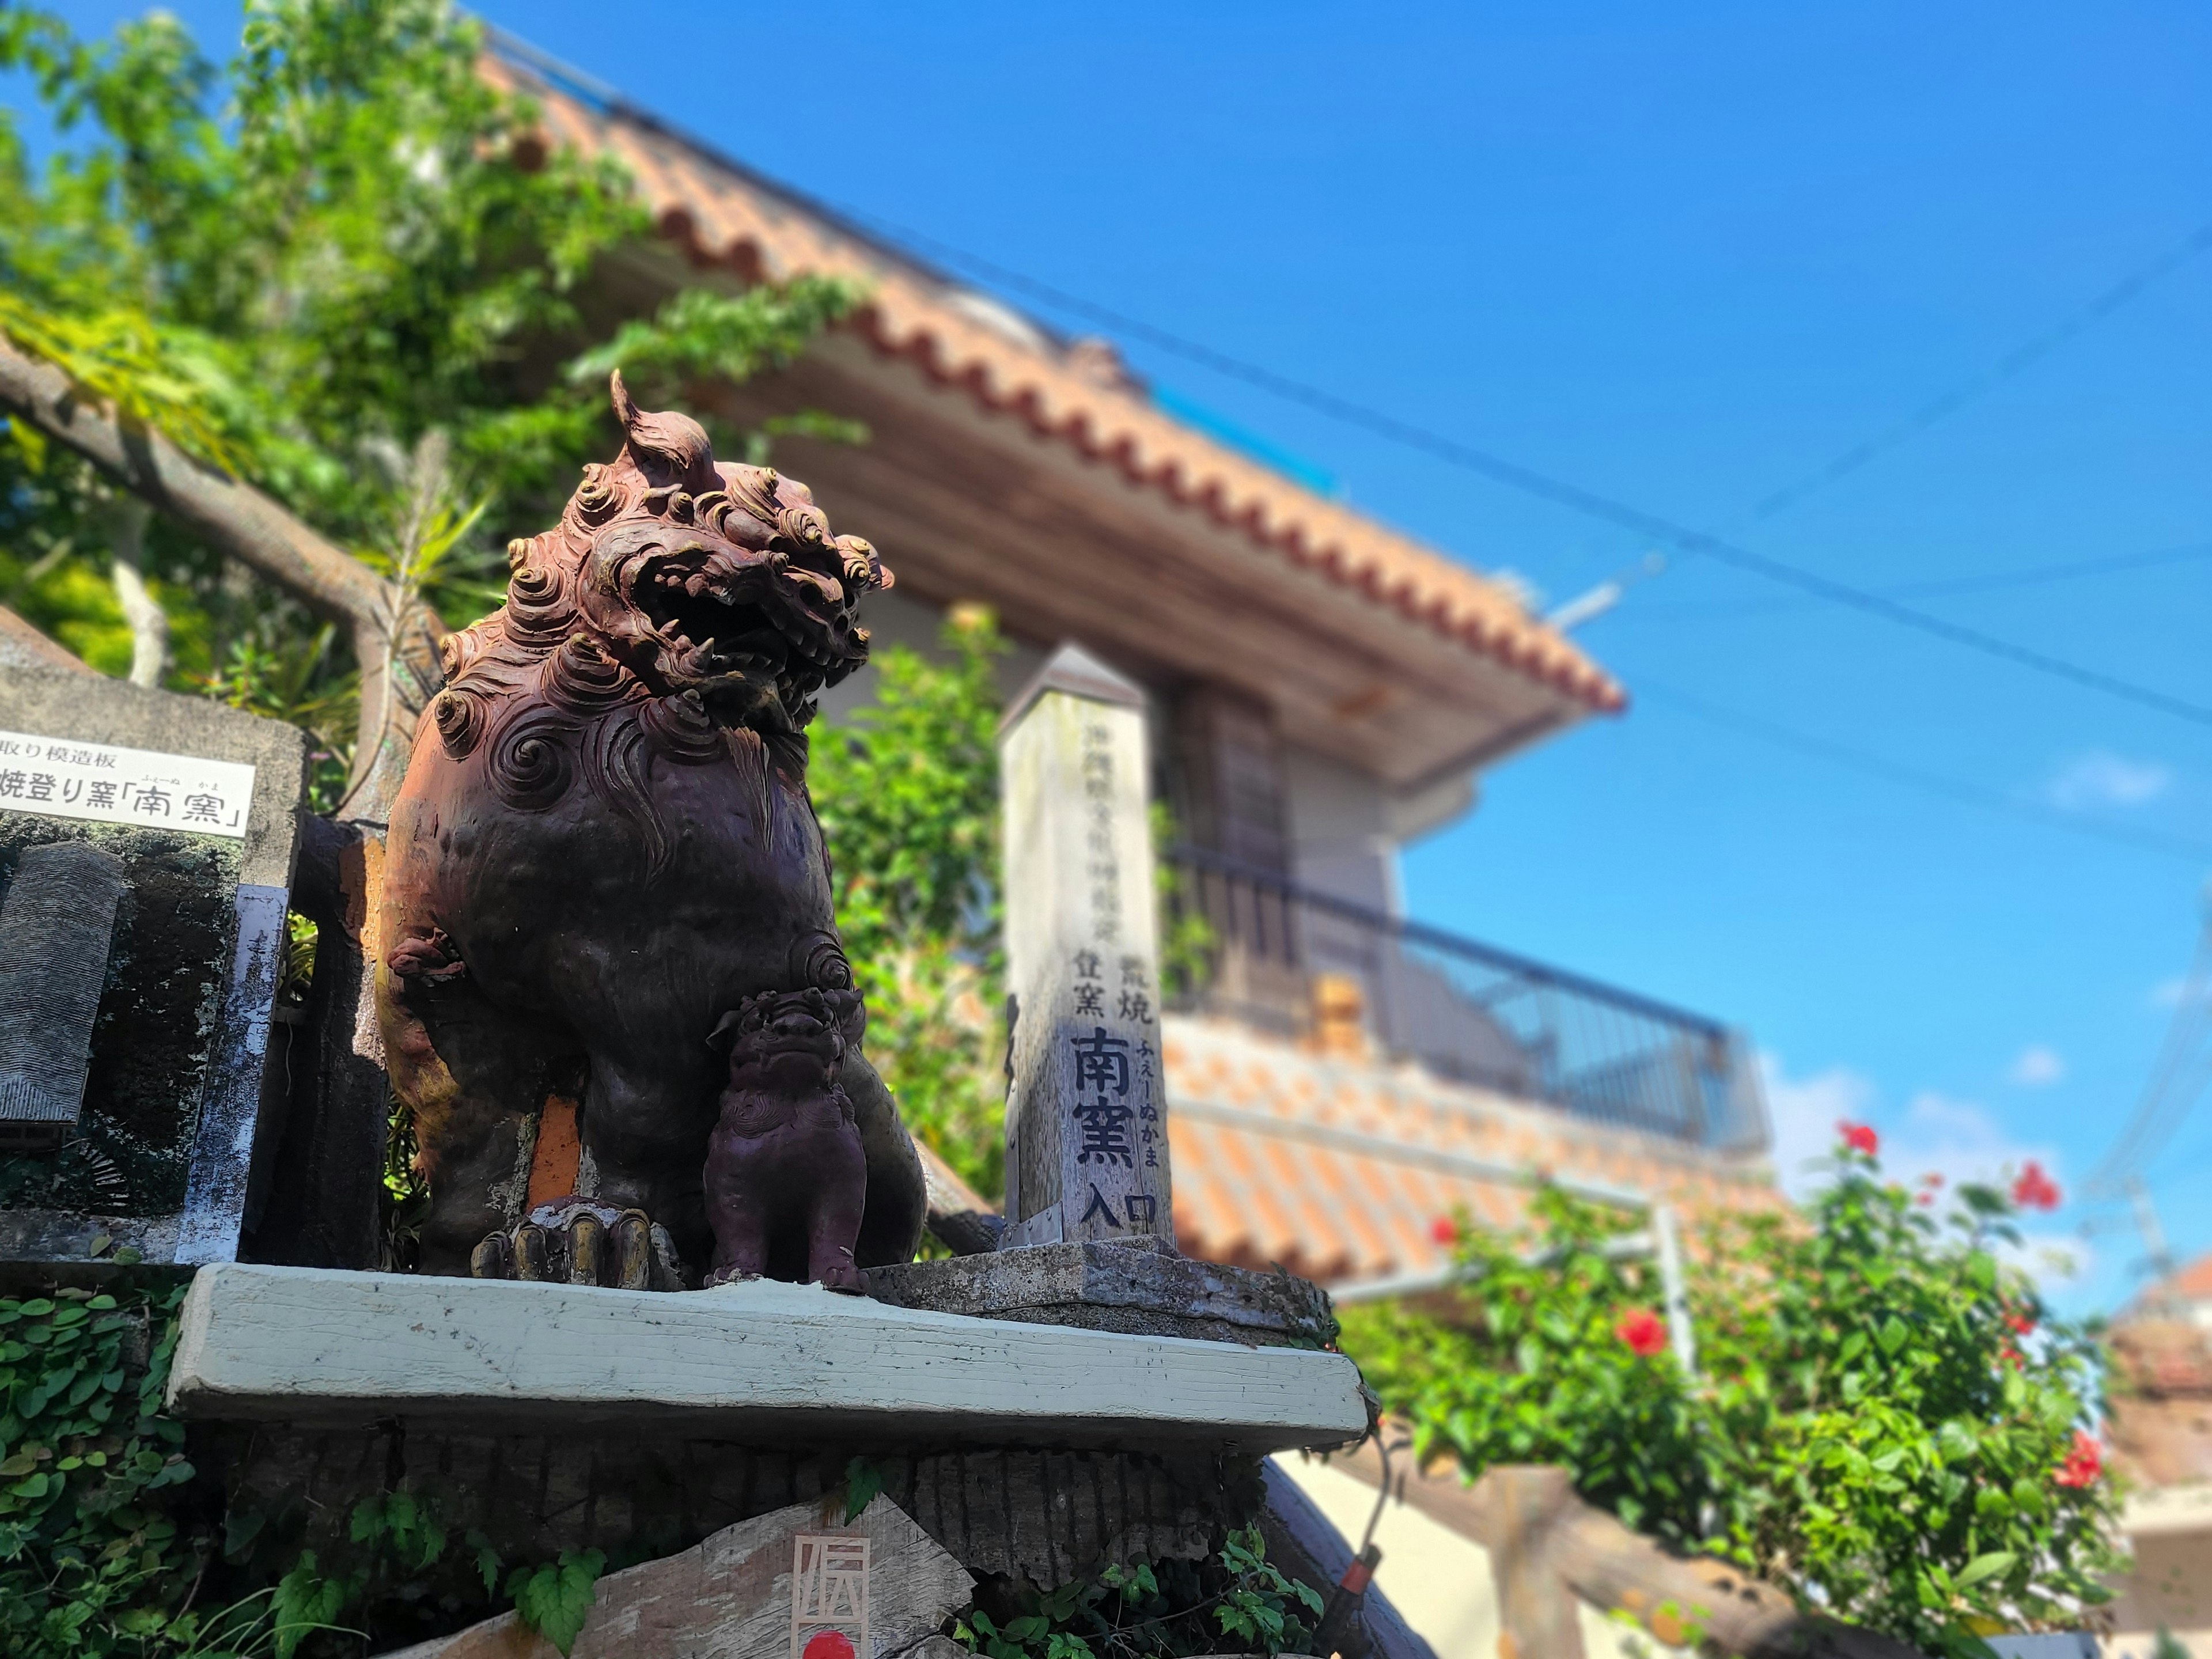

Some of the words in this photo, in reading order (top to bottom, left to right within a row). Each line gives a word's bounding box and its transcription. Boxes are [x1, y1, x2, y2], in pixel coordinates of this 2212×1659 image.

[0, 740, 117, 768] 取り模造板
[1081, 1183, 1156, 1228] 入口
